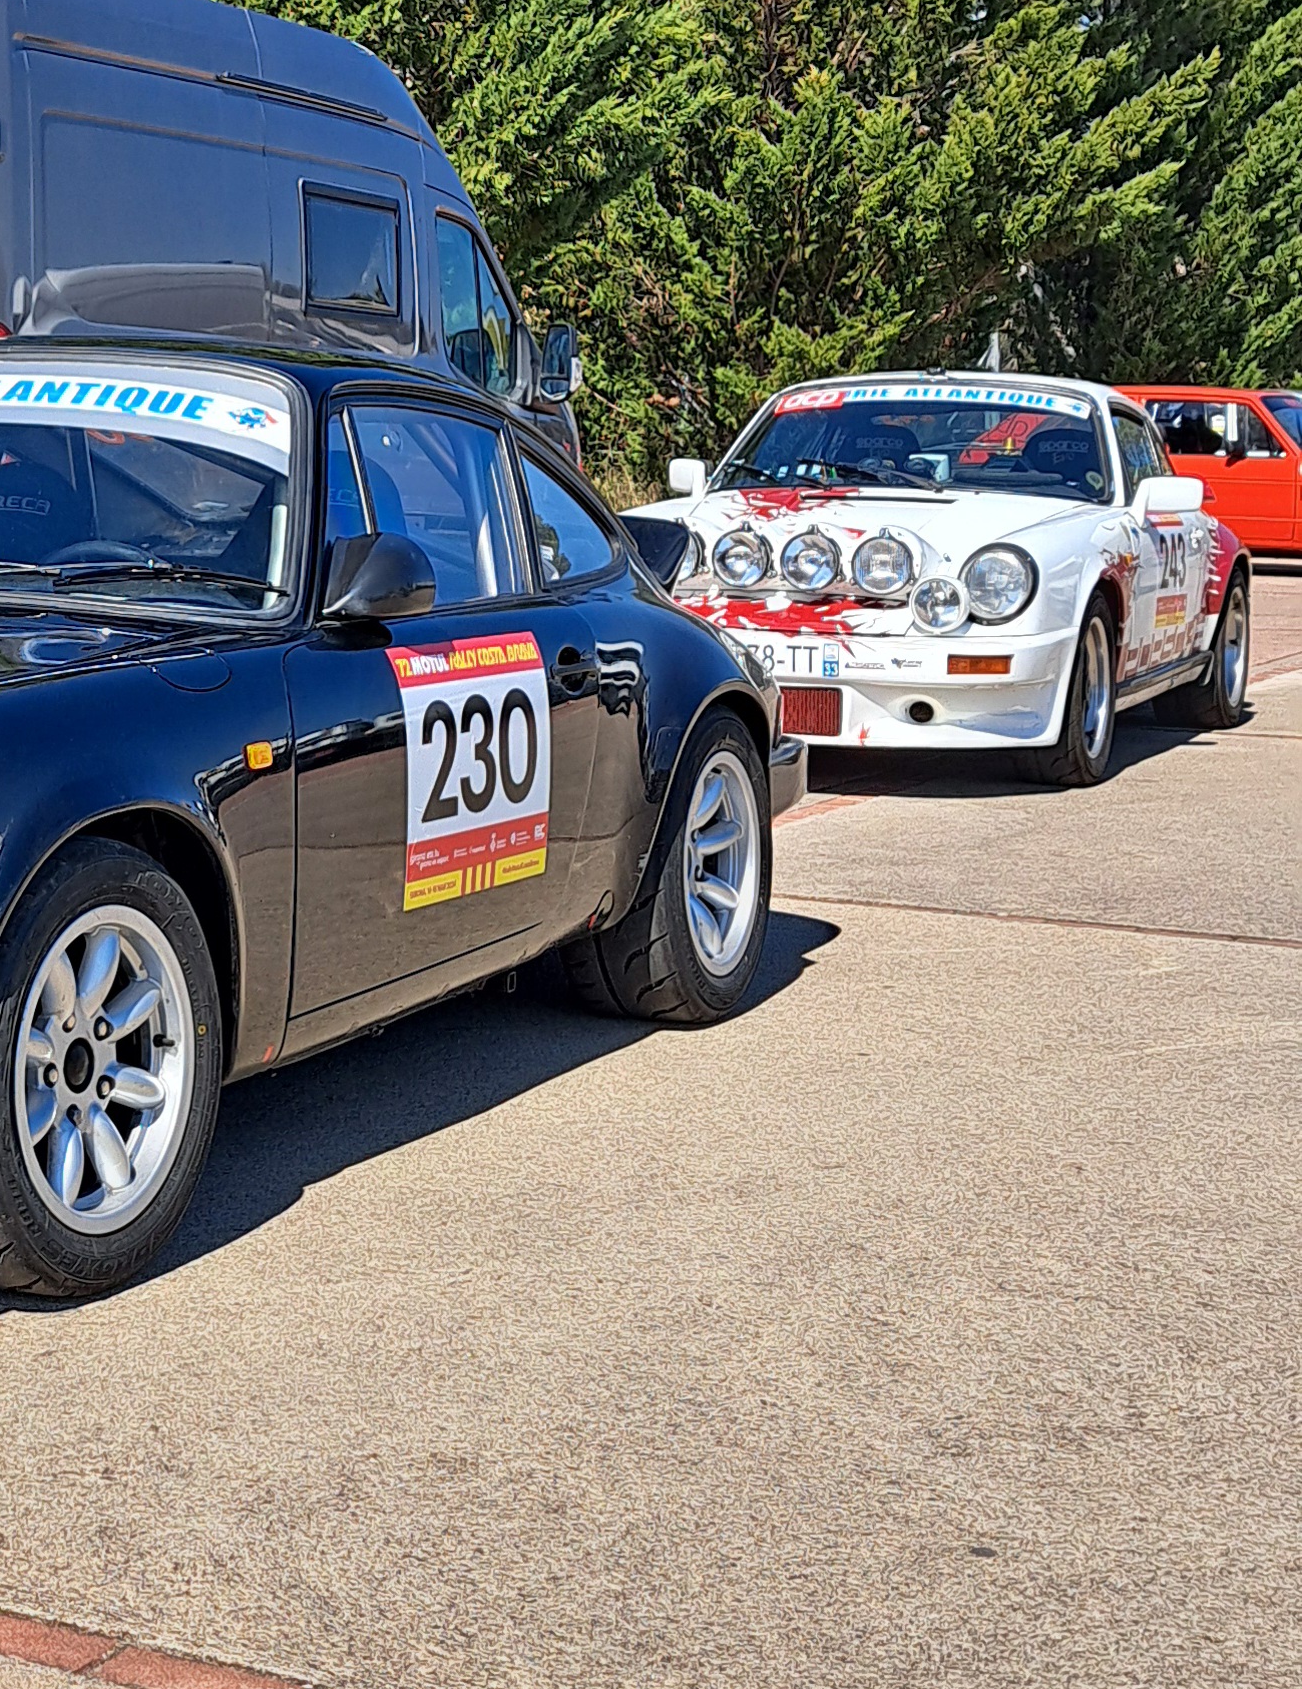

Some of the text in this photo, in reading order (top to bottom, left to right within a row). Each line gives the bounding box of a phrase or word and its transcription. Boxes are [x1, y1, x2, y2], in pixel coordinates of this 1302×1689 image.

[904, 387, 1058, 408] ATLANTIQUE
[856, 436, 904, 449] sparco
[1038, 439, 1089, 453] sparco
[1159, 532, 1187, 589] 243
[409, 653, 450, 677] MOTUL
[824, 662, 838, 677] 33
[421, 687, 537, 823] 230
